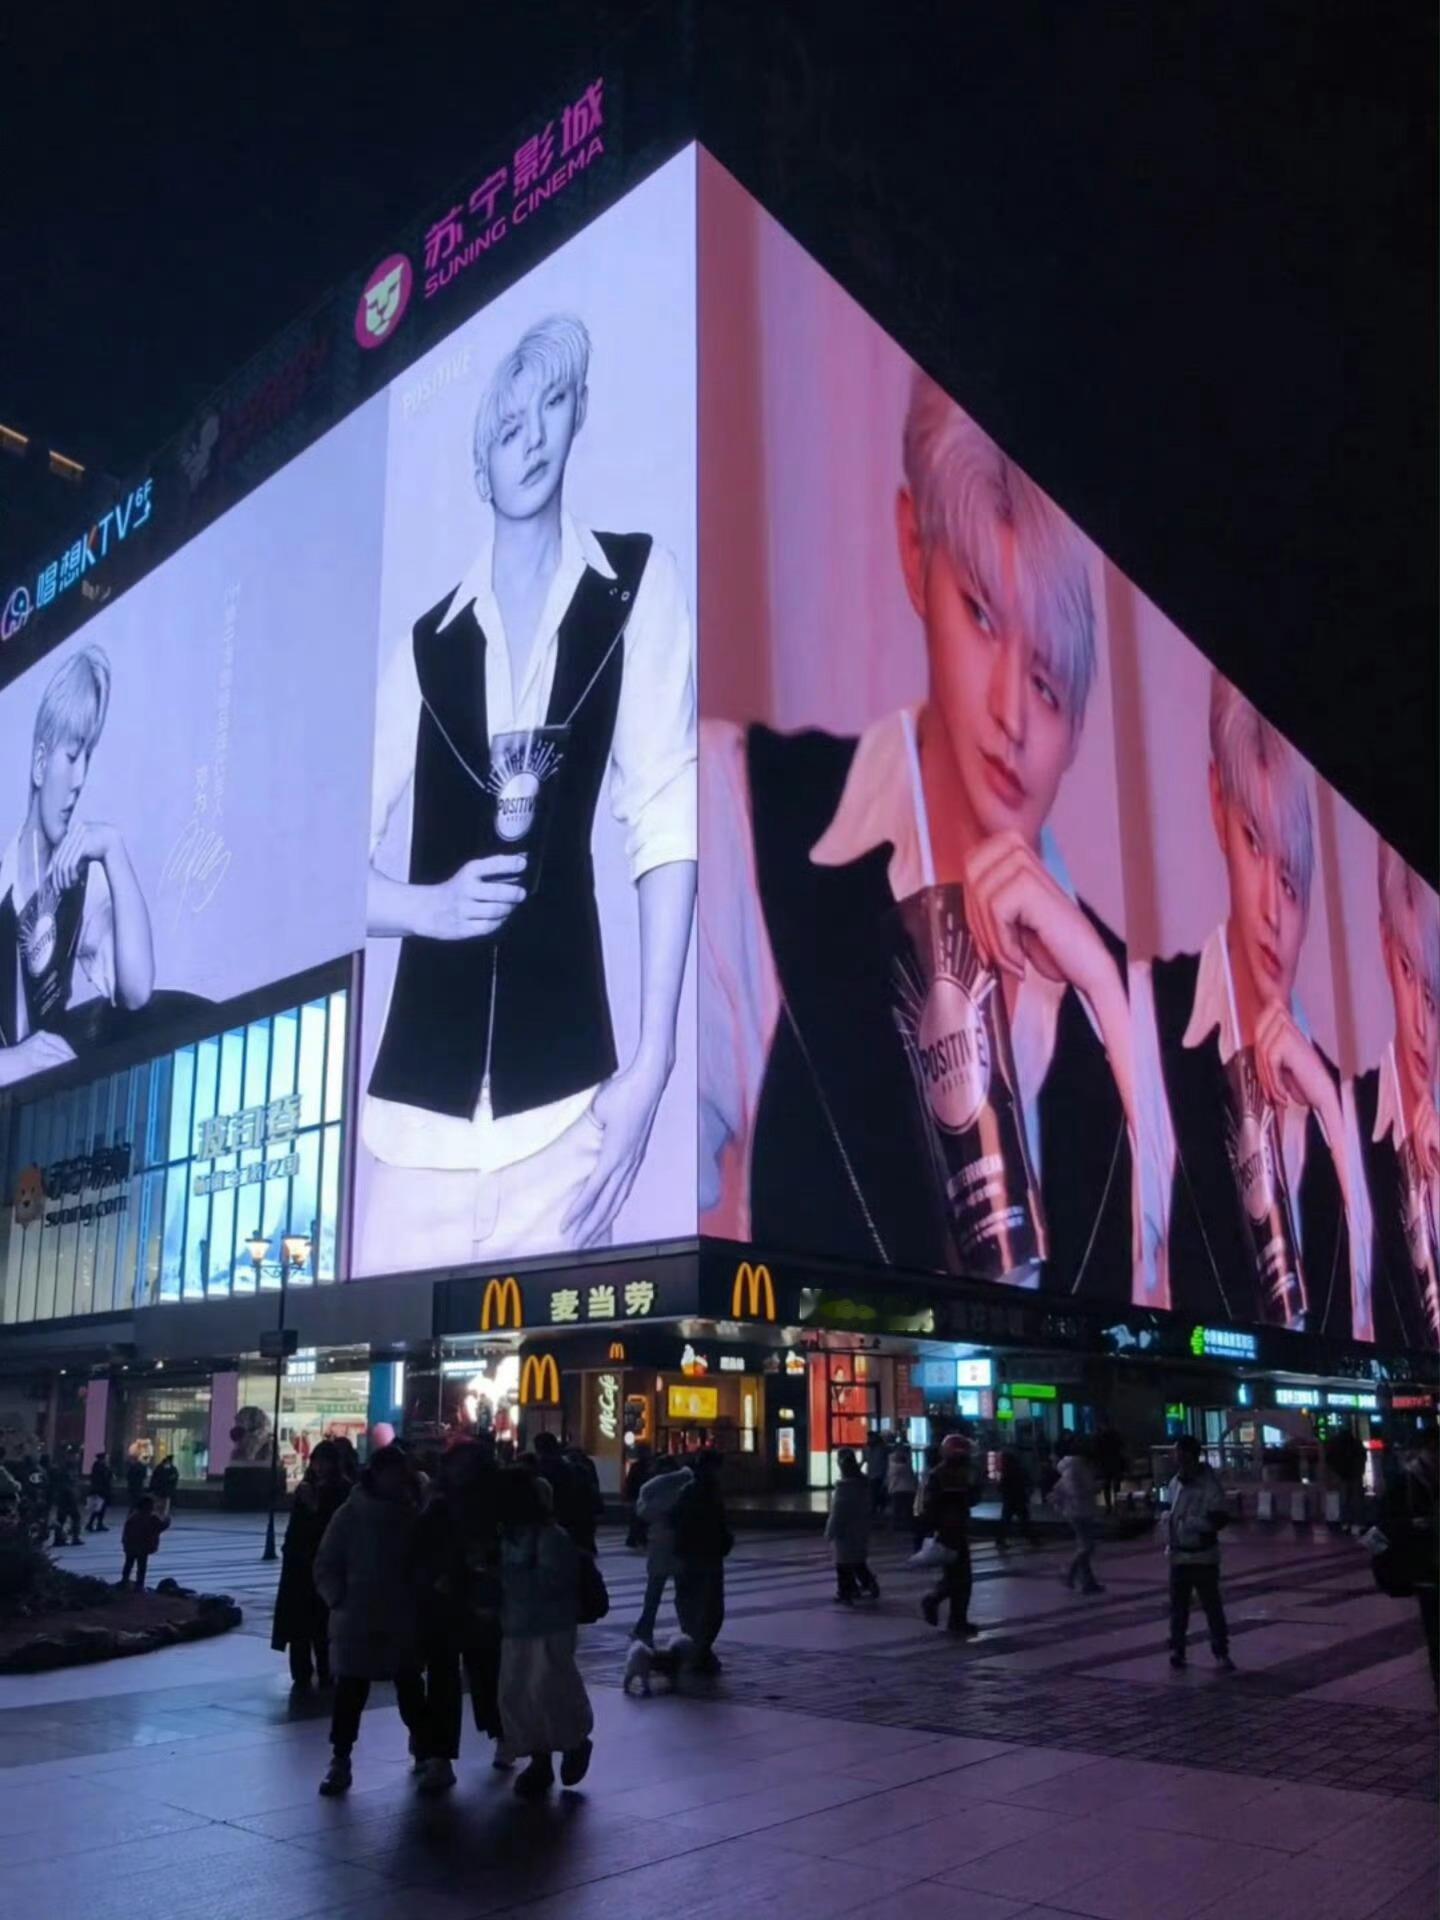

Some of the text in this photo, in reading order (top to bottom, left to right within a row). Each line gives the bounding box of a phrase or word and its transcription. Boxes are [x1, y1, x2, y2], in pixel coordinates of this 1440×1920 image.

[424, 76, 604, 270] 苏宁影城
[424, 135, 605, 299] SUNING CINEMA
[550, 1280, 655, 1322] 麦当劳
